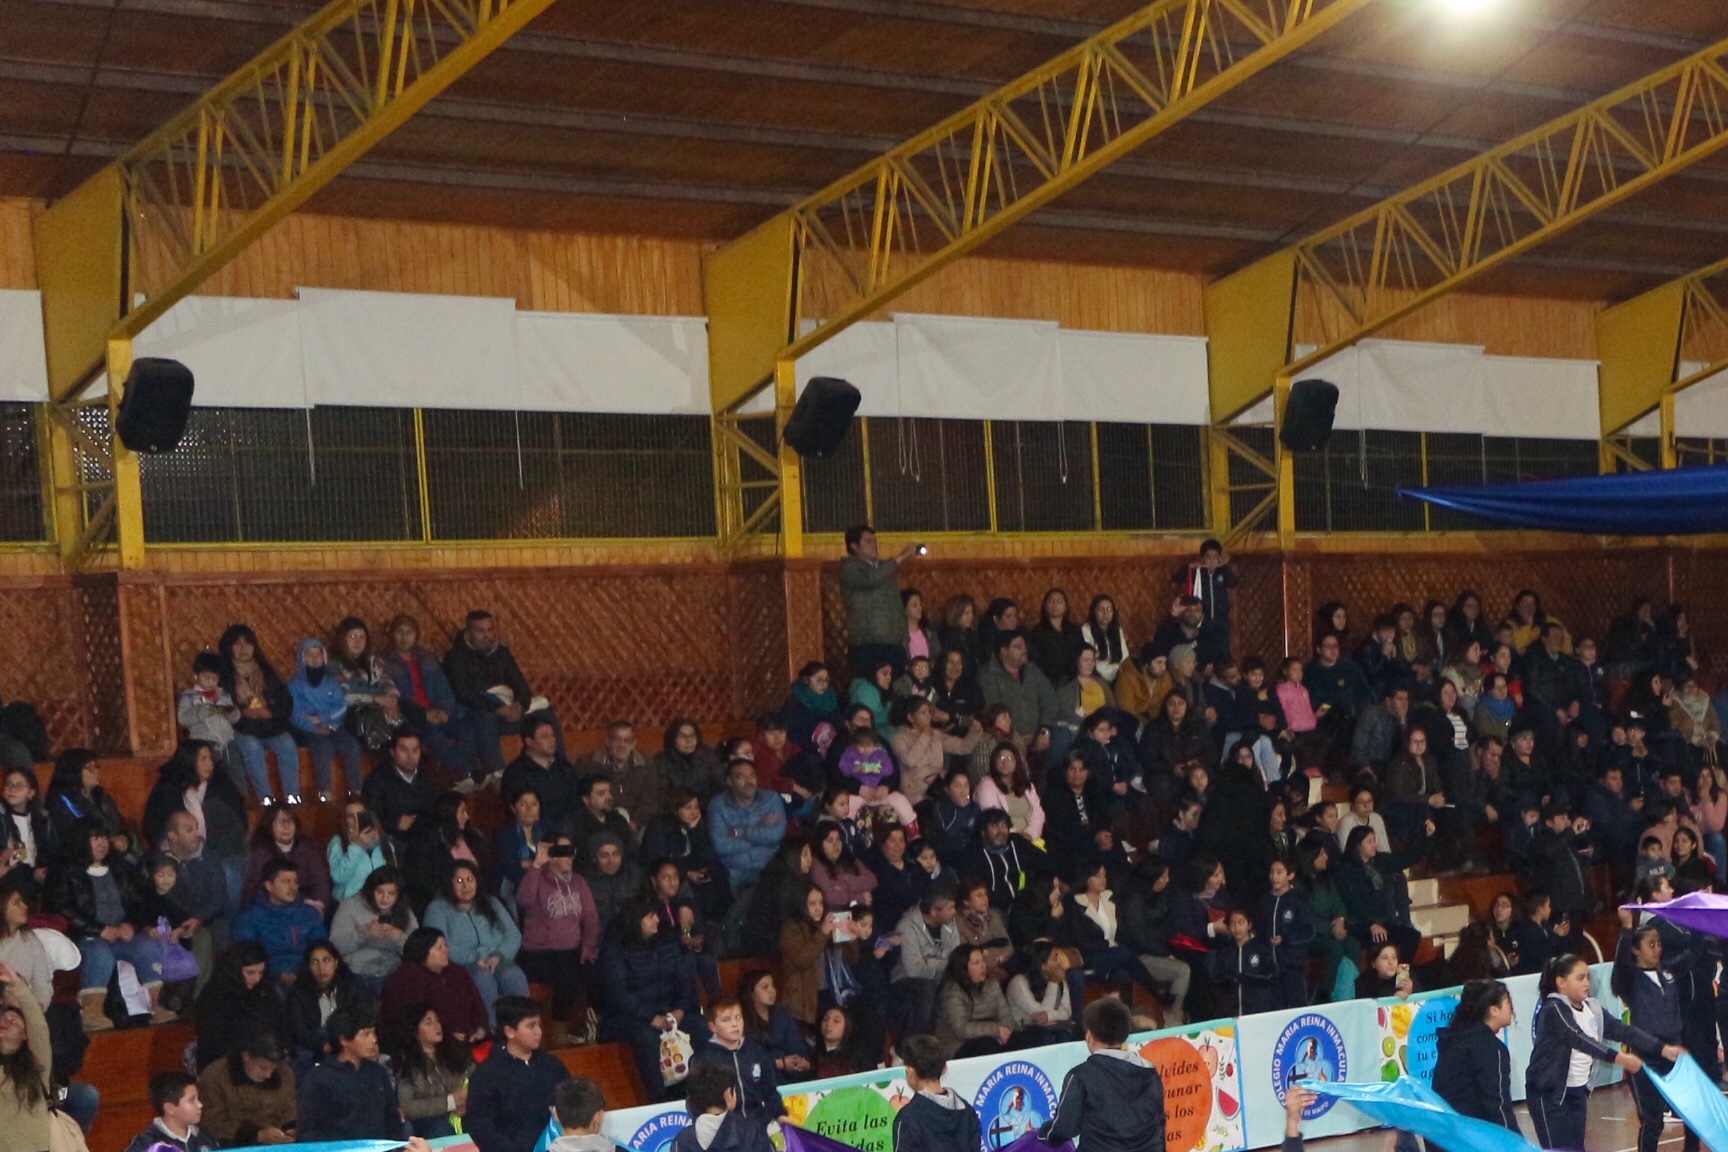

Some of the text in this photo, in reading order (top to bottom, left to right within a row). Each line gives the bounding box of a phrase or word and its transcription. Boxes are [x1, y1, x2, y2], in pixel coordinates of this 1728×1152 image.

[1425, 1011, 1437, 1024] Si
[1276, 1022, 1300, 1056] MARIA
[1300, 1015, 1326, 1029] REINA
[1326, 1024, 1346, 1082] INMACULA
[1160, 1060, 1199, 1078] lvides
[975, 1070, 1004, 1107] MARIA
[1005, 1064, 1034, 1077] REINA
[1165, 1084, 1202, 1099] unar
[1175, 1104, 1194, 1119] los
[632, 1114, 693, 1150] ARIA REINA
[816, 1114, 888, 1137] Evita las
[1166, 1129, 1182, 1142] as
